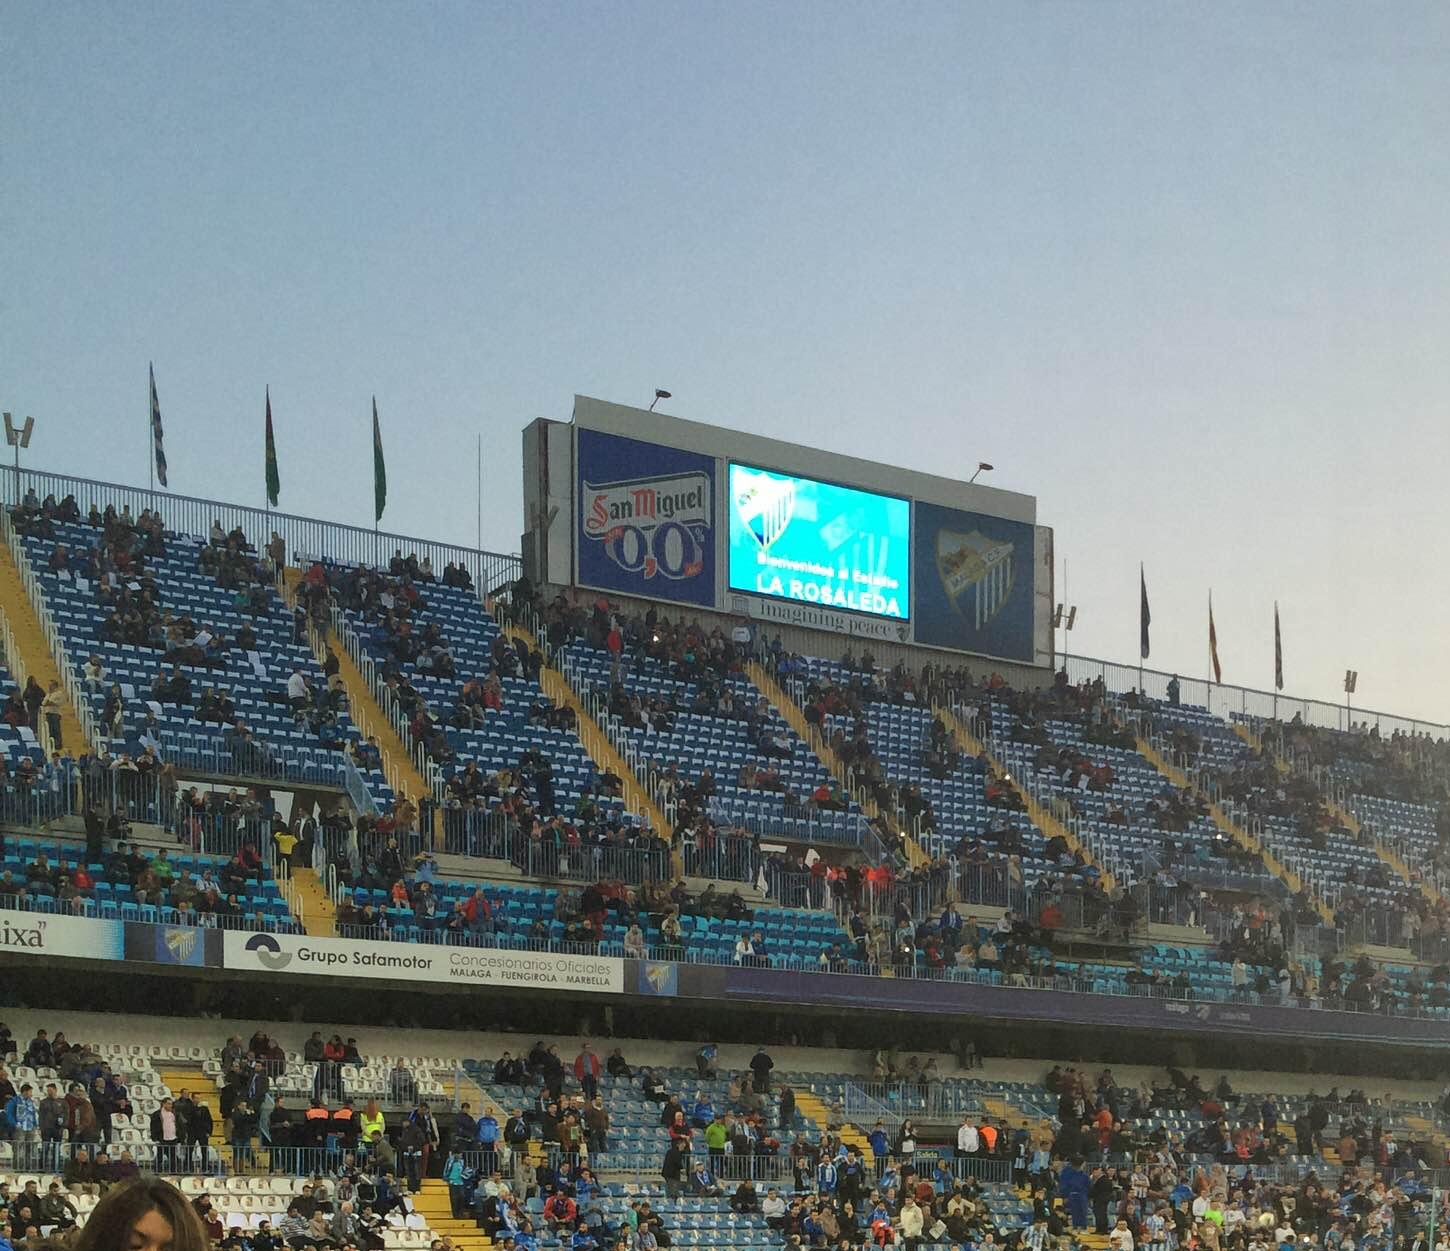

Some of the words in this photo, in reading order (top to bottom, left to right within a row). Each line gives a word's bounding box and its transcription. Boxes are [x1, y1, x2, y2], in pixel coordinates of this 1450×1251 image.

[587, 494, 632, 529] San
[630, 485, 702, 520] Miguel
[757, 573, 784, 595] LA
[789, 579, 901, 617] ROSALEDA
[760, 600, 844, 631] imagining
[849, 619, 891, 636] peace
[298, 948, 347, 965] Grupo
[352, 951, 432, 968] Safamotor
[449, 952, 552, 971] Concesionarios
[555, 959, 611, 975] Oficiales
[449, 968, 492, 978] MALAGA
[501, 971, 557, 982] FUENGIROLA
[566, 975, 610, 986] MARBELLA
